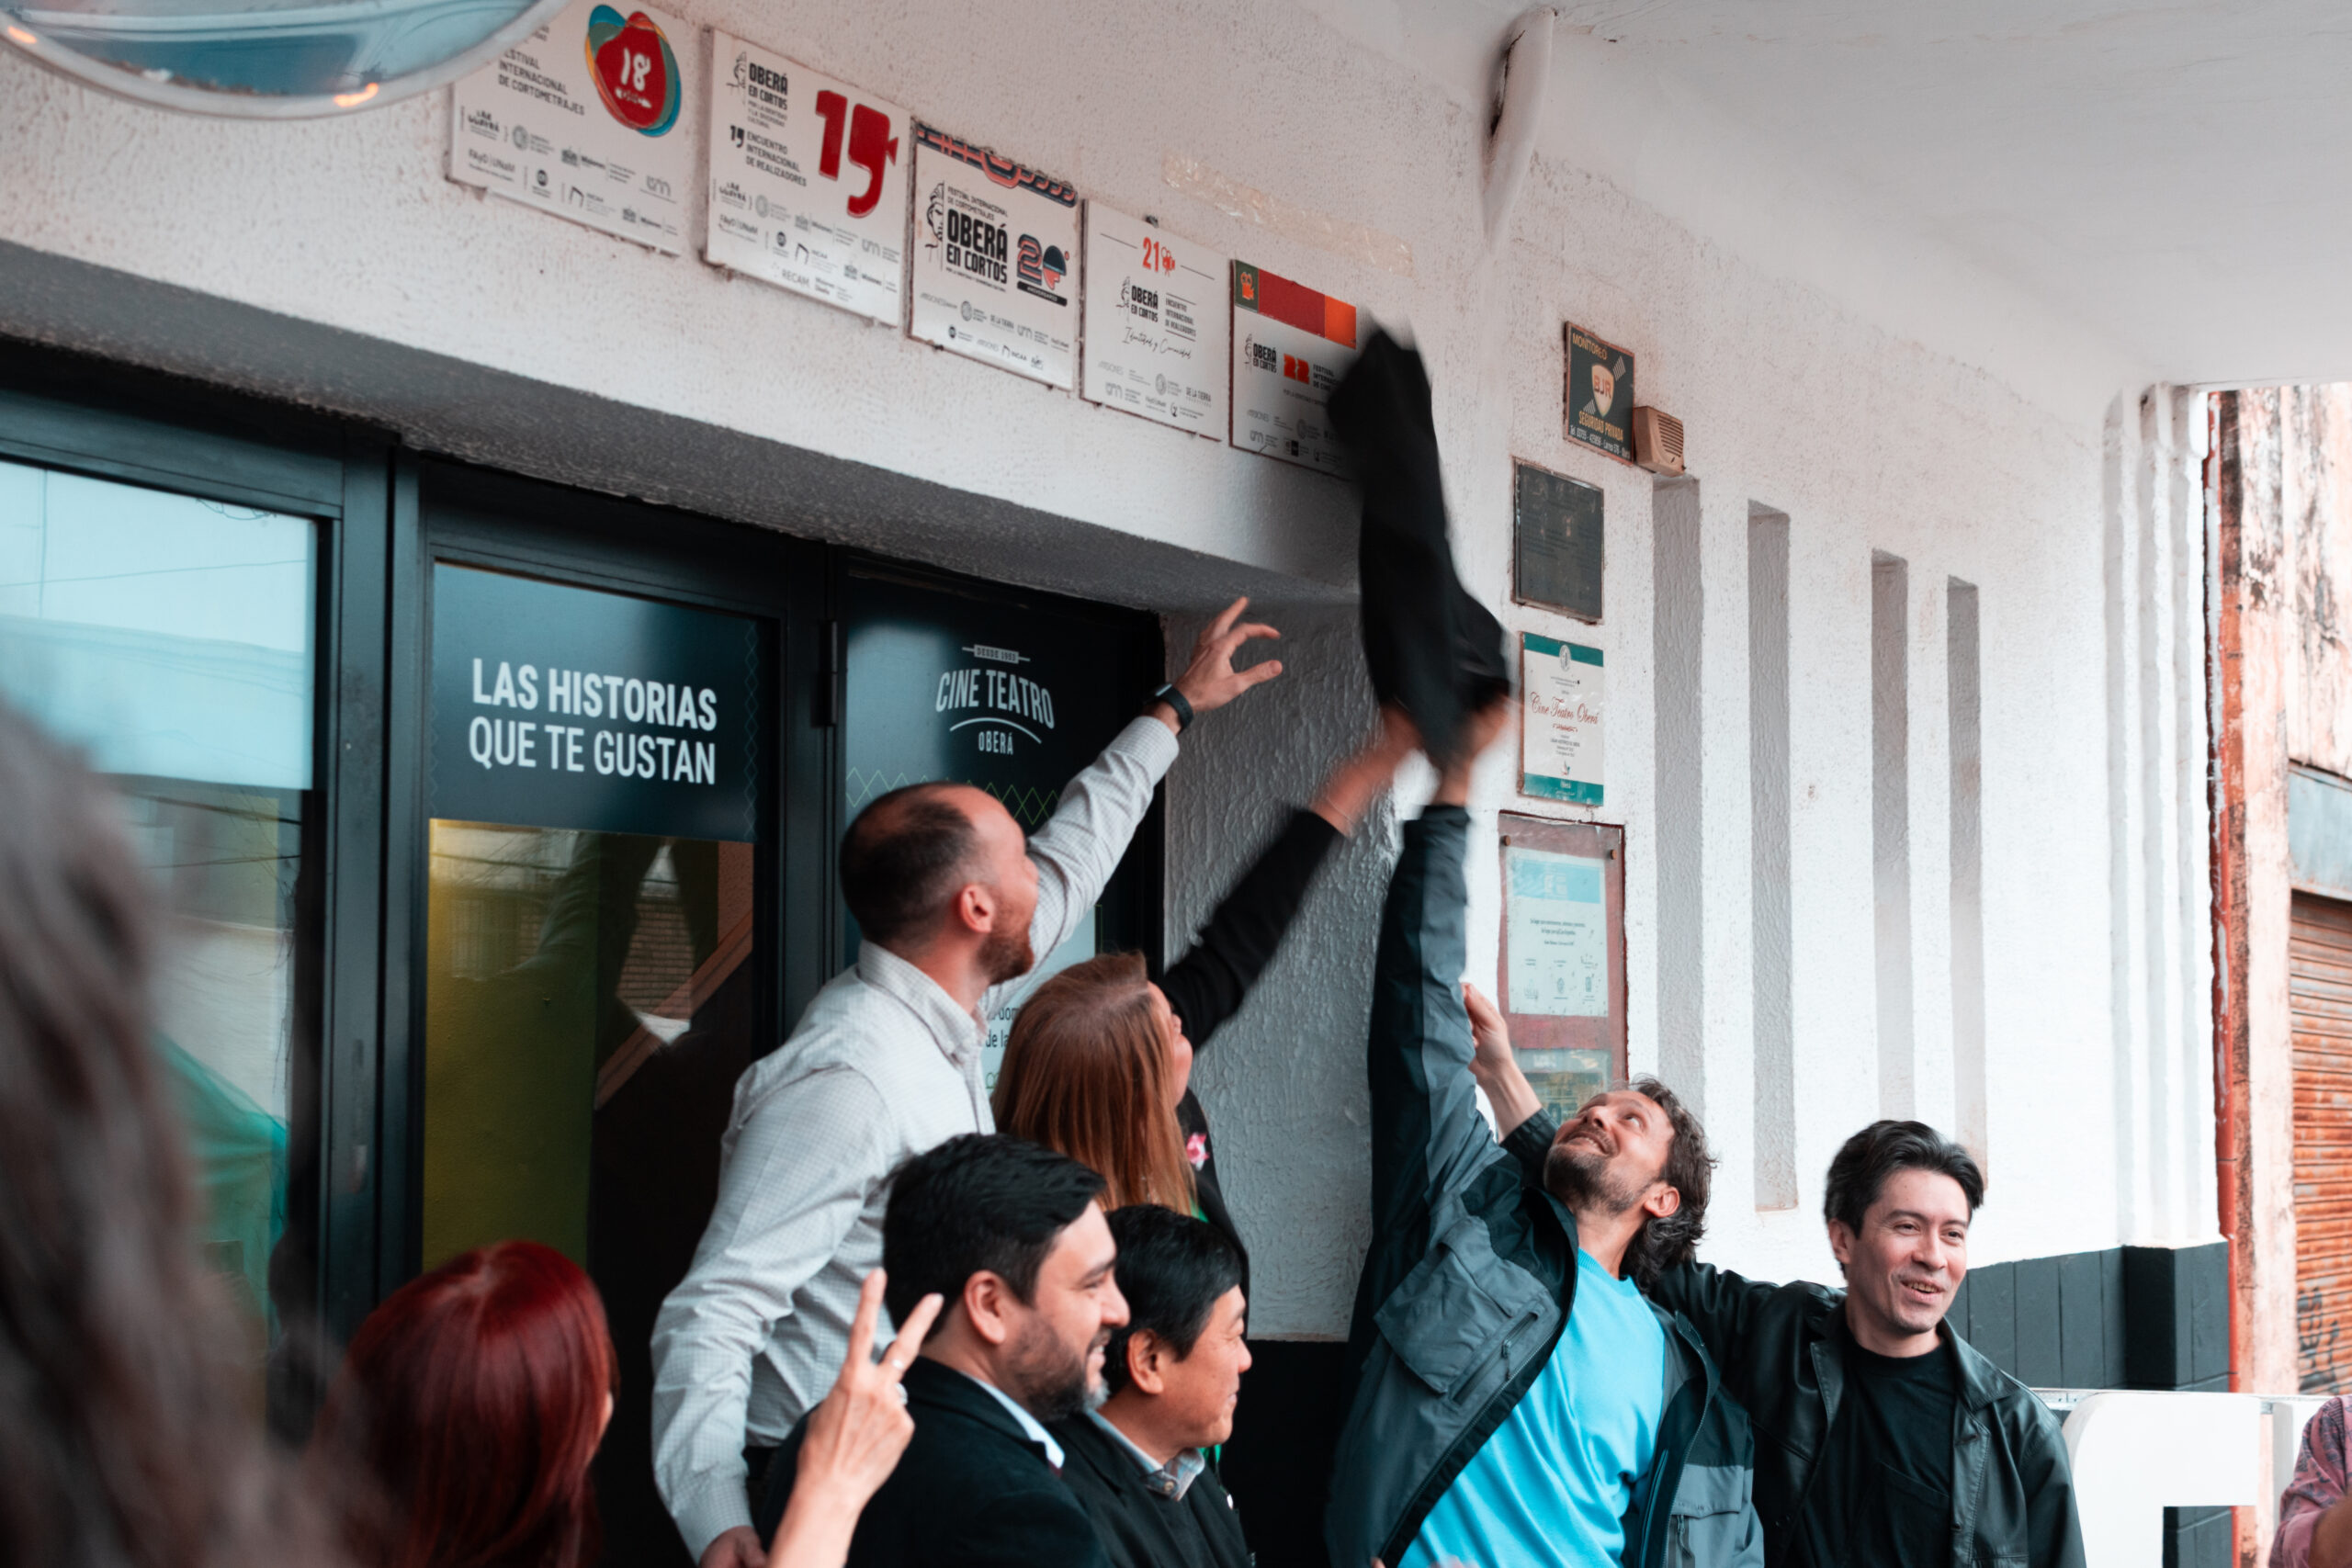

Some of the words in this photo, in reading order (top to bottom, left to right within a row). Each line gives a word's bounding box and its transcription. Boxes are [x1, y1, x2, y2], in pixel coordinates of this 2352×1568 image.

[499, 60, 568, 96] INTERNACIONAL
[621, 47, 651, 92] 18
[749, 62, 788, 96] OBERÁ
[498, 73, 510, 87] DE
[512, 79, 585, 116] CORTOMETRAJES
[748, 85, 758, 98] EN
[760, 89, 788, 111] CORTOS
[747, 130, 788, 154] ENCUENTRO
[746, 144, 800, 173] INTERNACIONAL
[746, 155, 755, 167] DE
[756, 160, 807, 187] REALIZADORES
[947, 186, 970, 201] FESTIVAL
[970, 196, 1008, 218] INTERNACIONAL
[947, 197, 955, 206] DE
[956, 200, 995, 220] CORTOMETRAJES
[946, 209, 1008, 264] OBERÁ
[946, 243, 960, 267] EN
[965, 250, 1008, 285] CORTOS
[1142, 237, 1159, 273] 21
[1130, 304, 1137, 314] EN
[1138, 307, 1159, 323] CORTOS
[1131, 285, 1159, 310] OBERÁ
[1253, 343, 1276, 364] OBERÁ
[1572, 333, 1608, 360] MONITOREO
[1260, 360, 1277, 374] CORTOS
[1283, 353, 1310, 385] 22
[1593, 375, 1611, 399] BJR
[1578, 411, 1604, 434] SEGURIDAD
[1604, 421, 1623, 442] PRIVADA
[473, 658, 538, 710] LAS
[548, 668, 718, 731] HISTORIAS
[935, 669, 980, 713] CINE
[986, 669, 1055, 729] TEATRO
[1530, 691, 1550, 714] Cine
[1551, 696, 1574, 720] Teatro
[1577, 703, 1599, 725] Oberá
[469, 716, 537, 770] QUE
[545, 725, 585, 773] TE
[594, 729, 716, 785] GUSTAN
[978, 730, 1014, 755] OBERÁ
